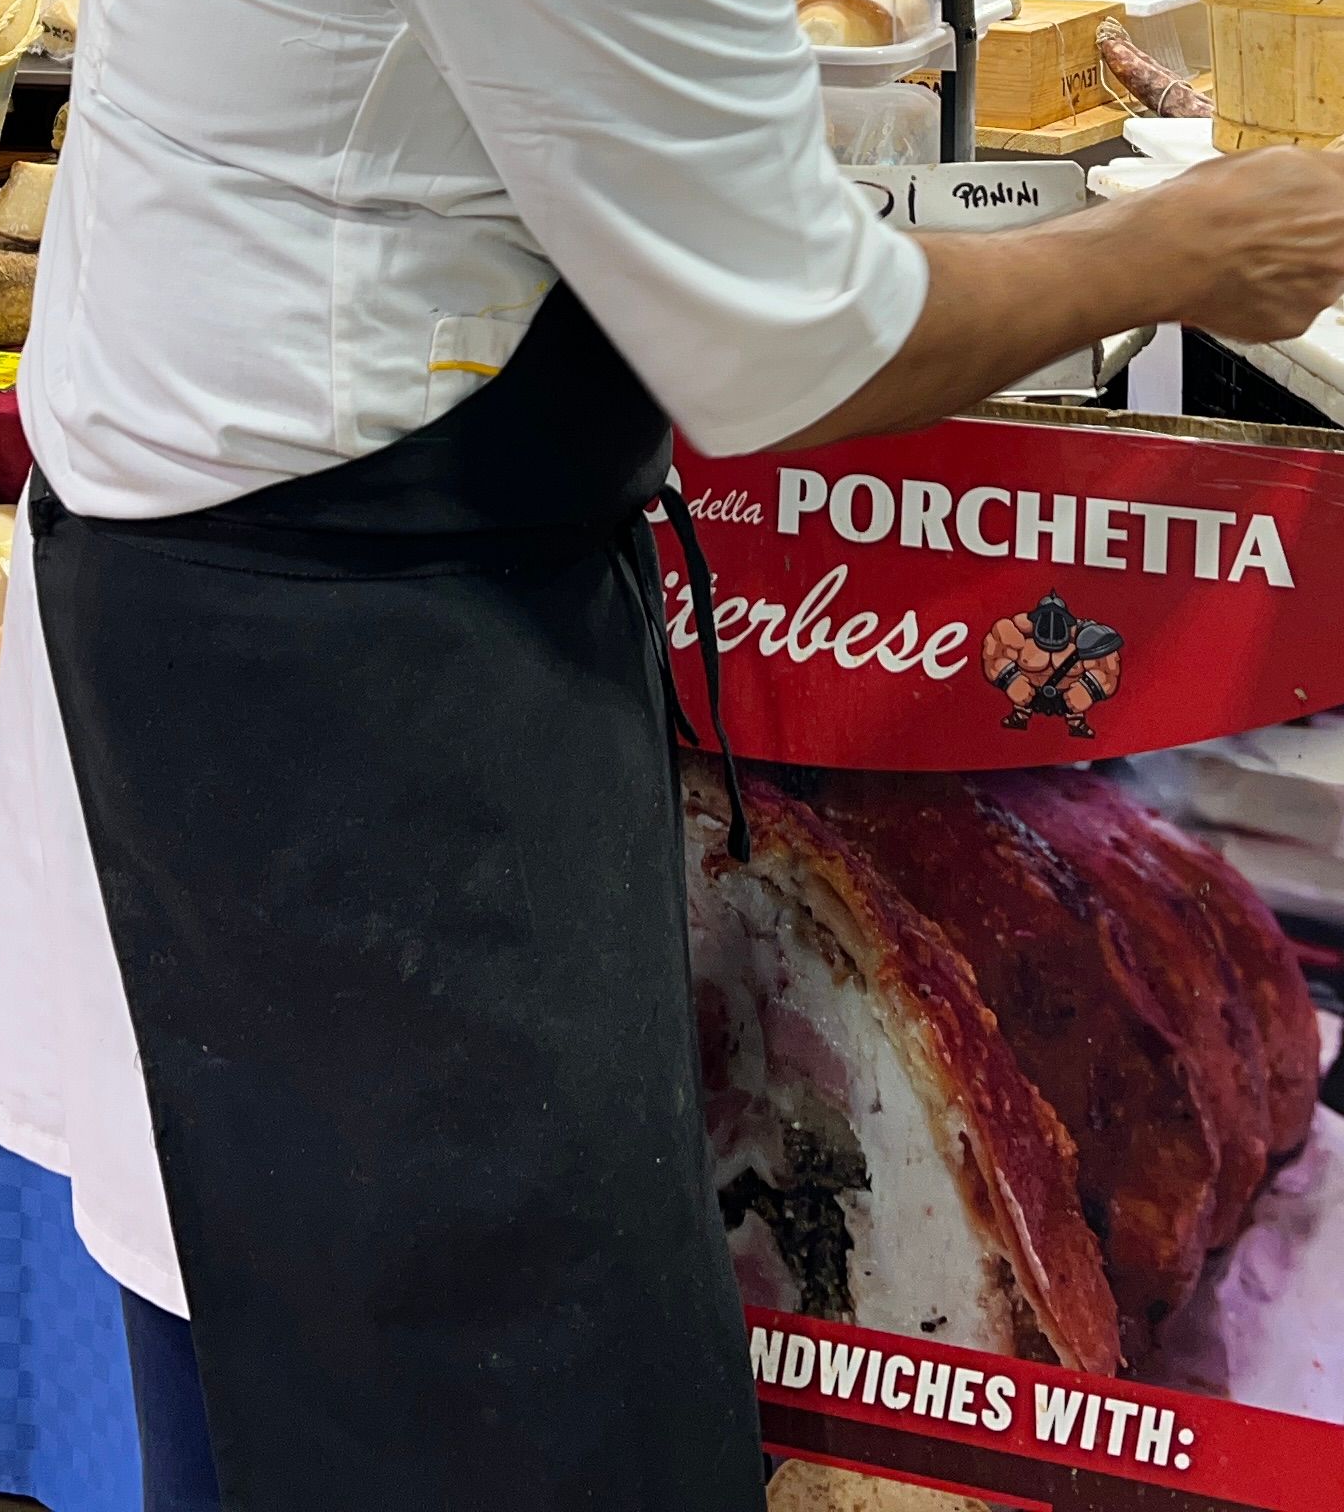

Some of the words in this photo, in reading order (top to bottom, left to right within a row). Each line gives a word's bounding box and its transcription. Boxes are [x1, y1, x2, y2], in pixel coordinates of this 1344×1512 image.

[952, 180, 1039, 209] PANINI
[685, 488, 764, 525] della
[777, 466, 1296, 589] PORCHETTA
[662, 563, 969, 680] iterbese
[749, 1326, 1017, 1432] NDWICHES
[1034, 1381, 1195, 1471] WITH:
